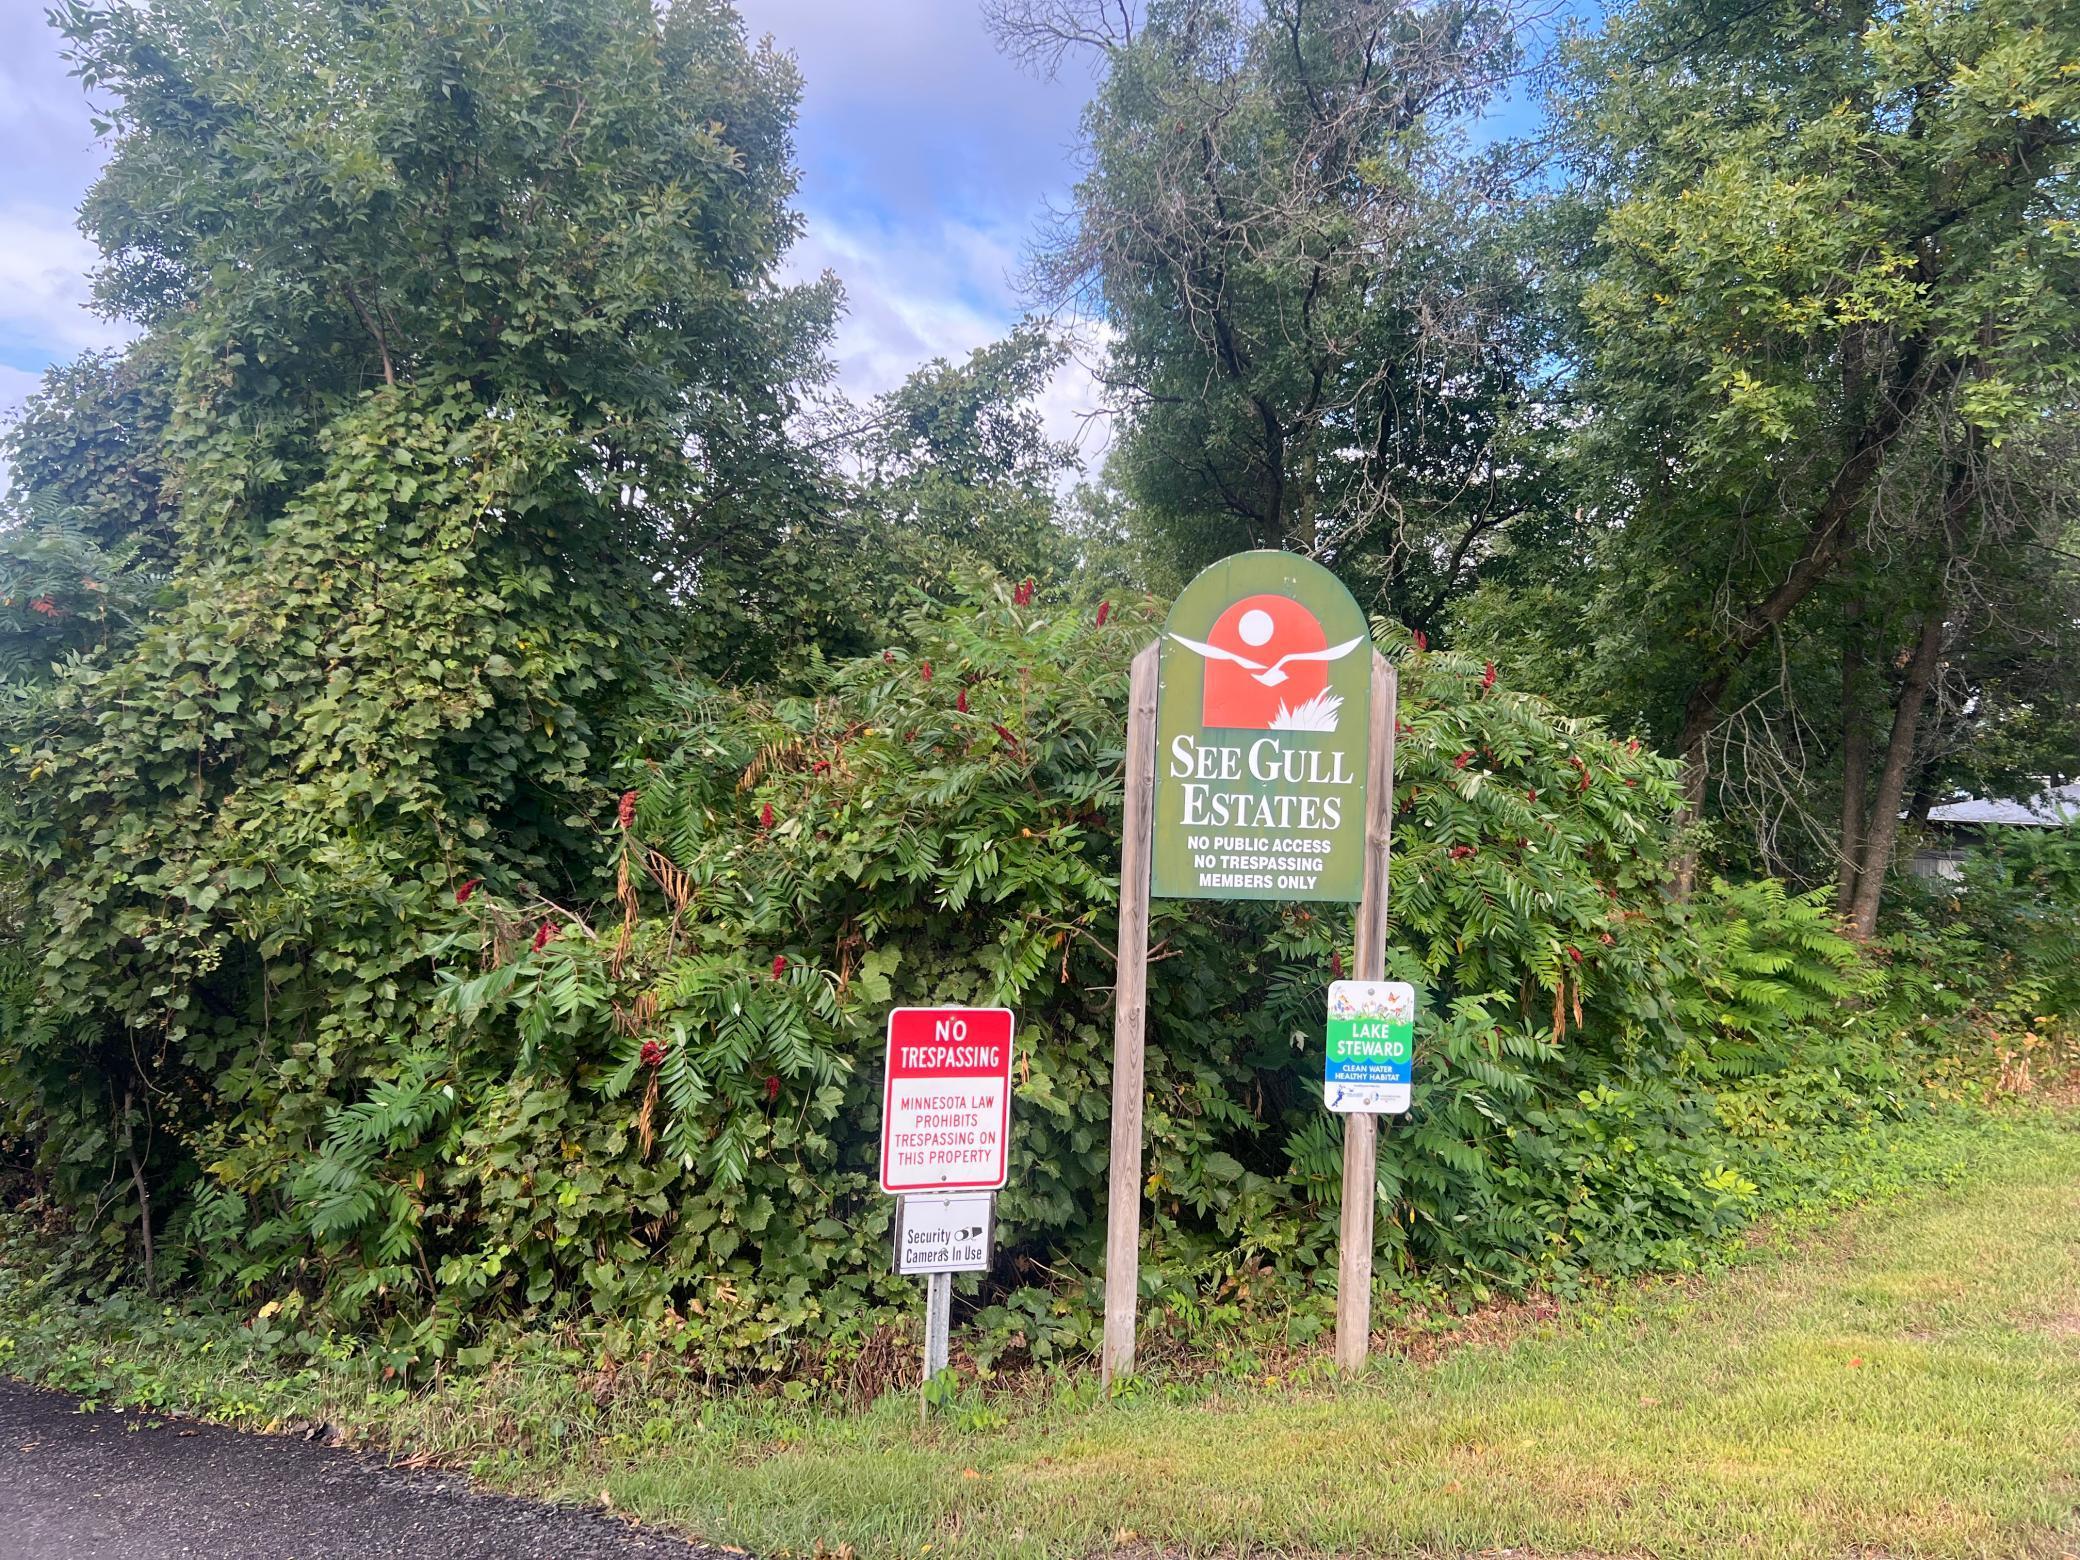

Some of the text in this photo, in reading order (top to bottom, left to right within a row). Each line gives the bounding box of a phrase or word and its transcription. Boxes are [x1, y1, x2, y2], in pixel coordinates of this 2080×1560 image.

[1170, 735, 1353, 784] SEE GULL
[1180, 783, 1341, 830] ESTATES
[1188, 836, 1331, 854] NO PUBLIC ACCESS
[1194, 855, 1323, 871] NO TRESPASSING
[1199, 874, 1317, 889] MEMBERS ONLY
[935, 1020, 967, 1042] NO
[1352, 1024, 1389, 1038] LAKE
[1338, 1040, 1403, 1056] STEWARD
[901, 1047, 999, 1068] TRESPASSING
[901, 1096, 994, 1110] MINNESOTA LAW
[916, 1114, 978, 1128] PROHIBITS
[895, 1131, 996, 1147] TRESPASSING ON
[898, 1149, 992, 1165] THIS PROPERTY
[908, 1227, 951, 1246] Security
[906, 1246, 982, 1264] Cameras In Use
